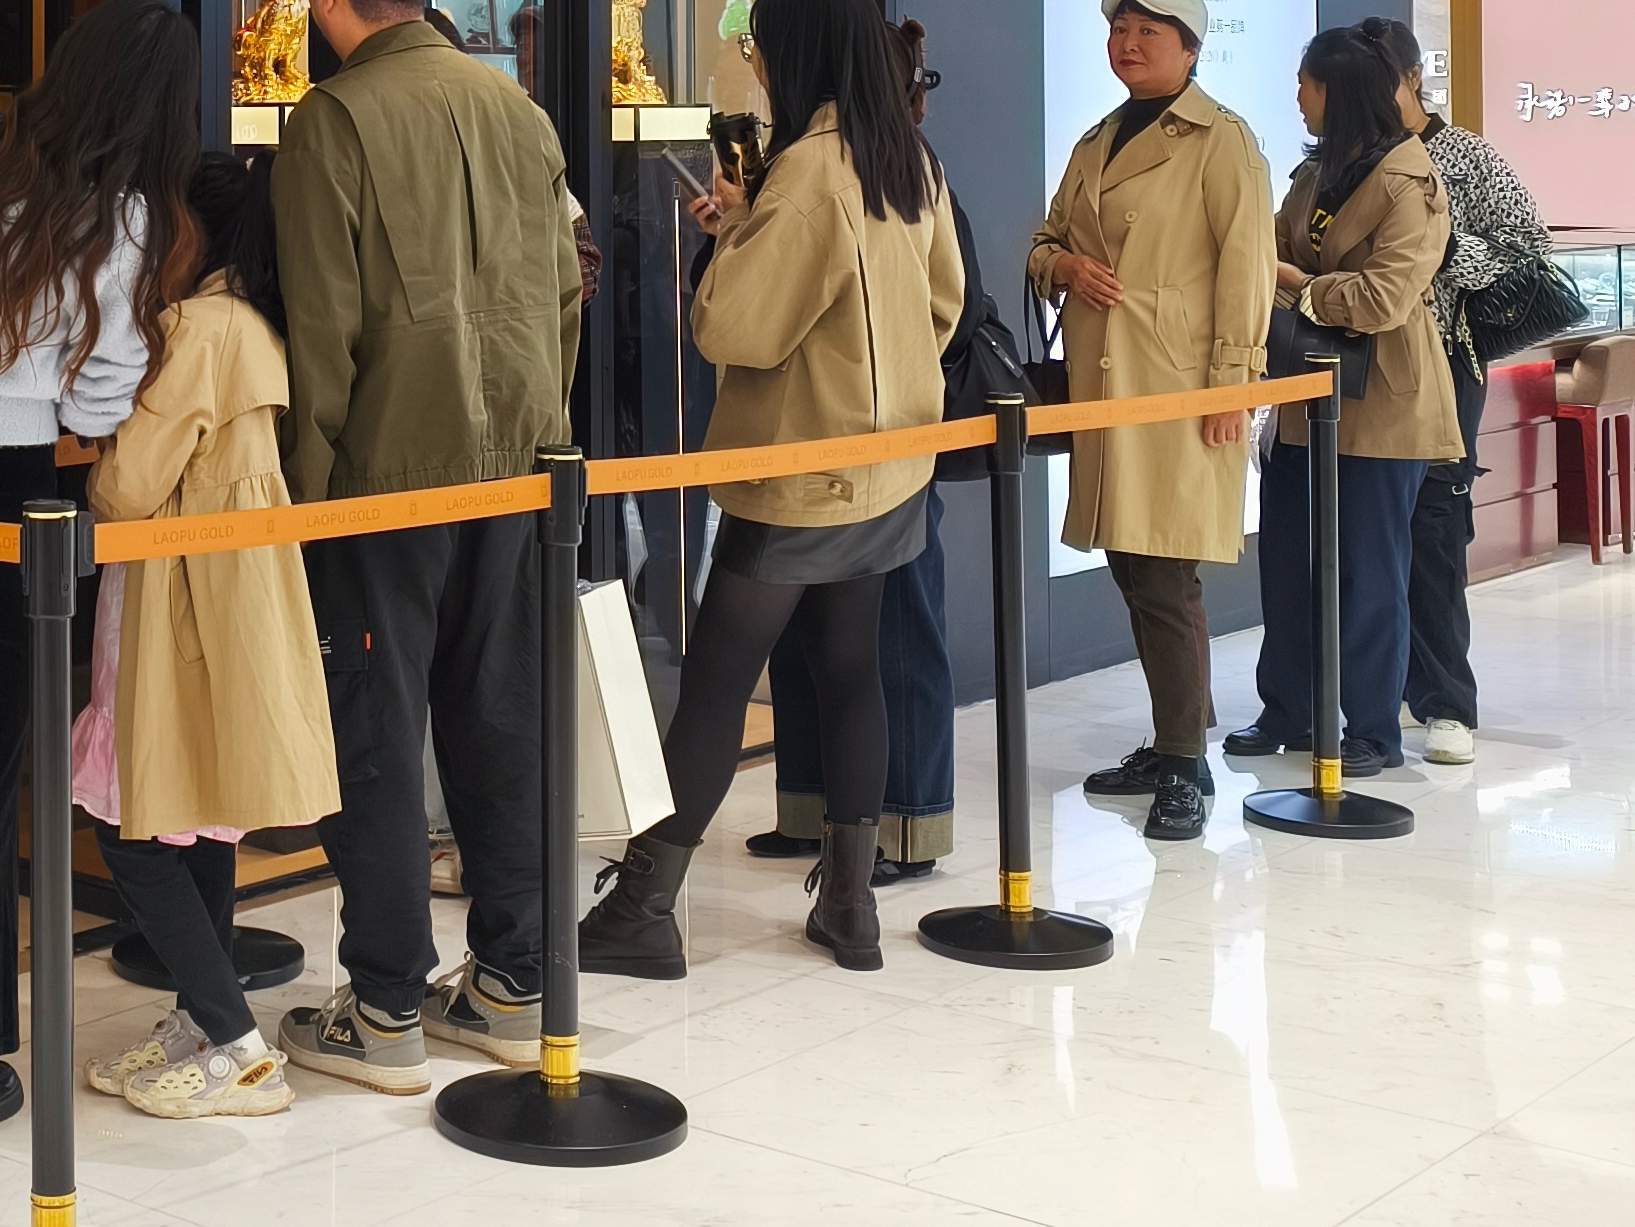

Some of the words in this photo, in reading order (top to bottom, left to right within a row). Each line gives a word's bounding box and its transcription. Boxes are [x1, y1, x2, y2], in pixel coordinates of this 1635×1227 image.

[445, 495, 482, 511] LAOPU
[484, 491, 514, 506] GOLD
[306, 511, 345, 528] LAOPU
[348, 507, 380, 523] GOLD
[153, 528, 196, 545] LAOPU
[199, 524, 234, 541] GOLD
[327, 1026, 351, 1043] FILA
